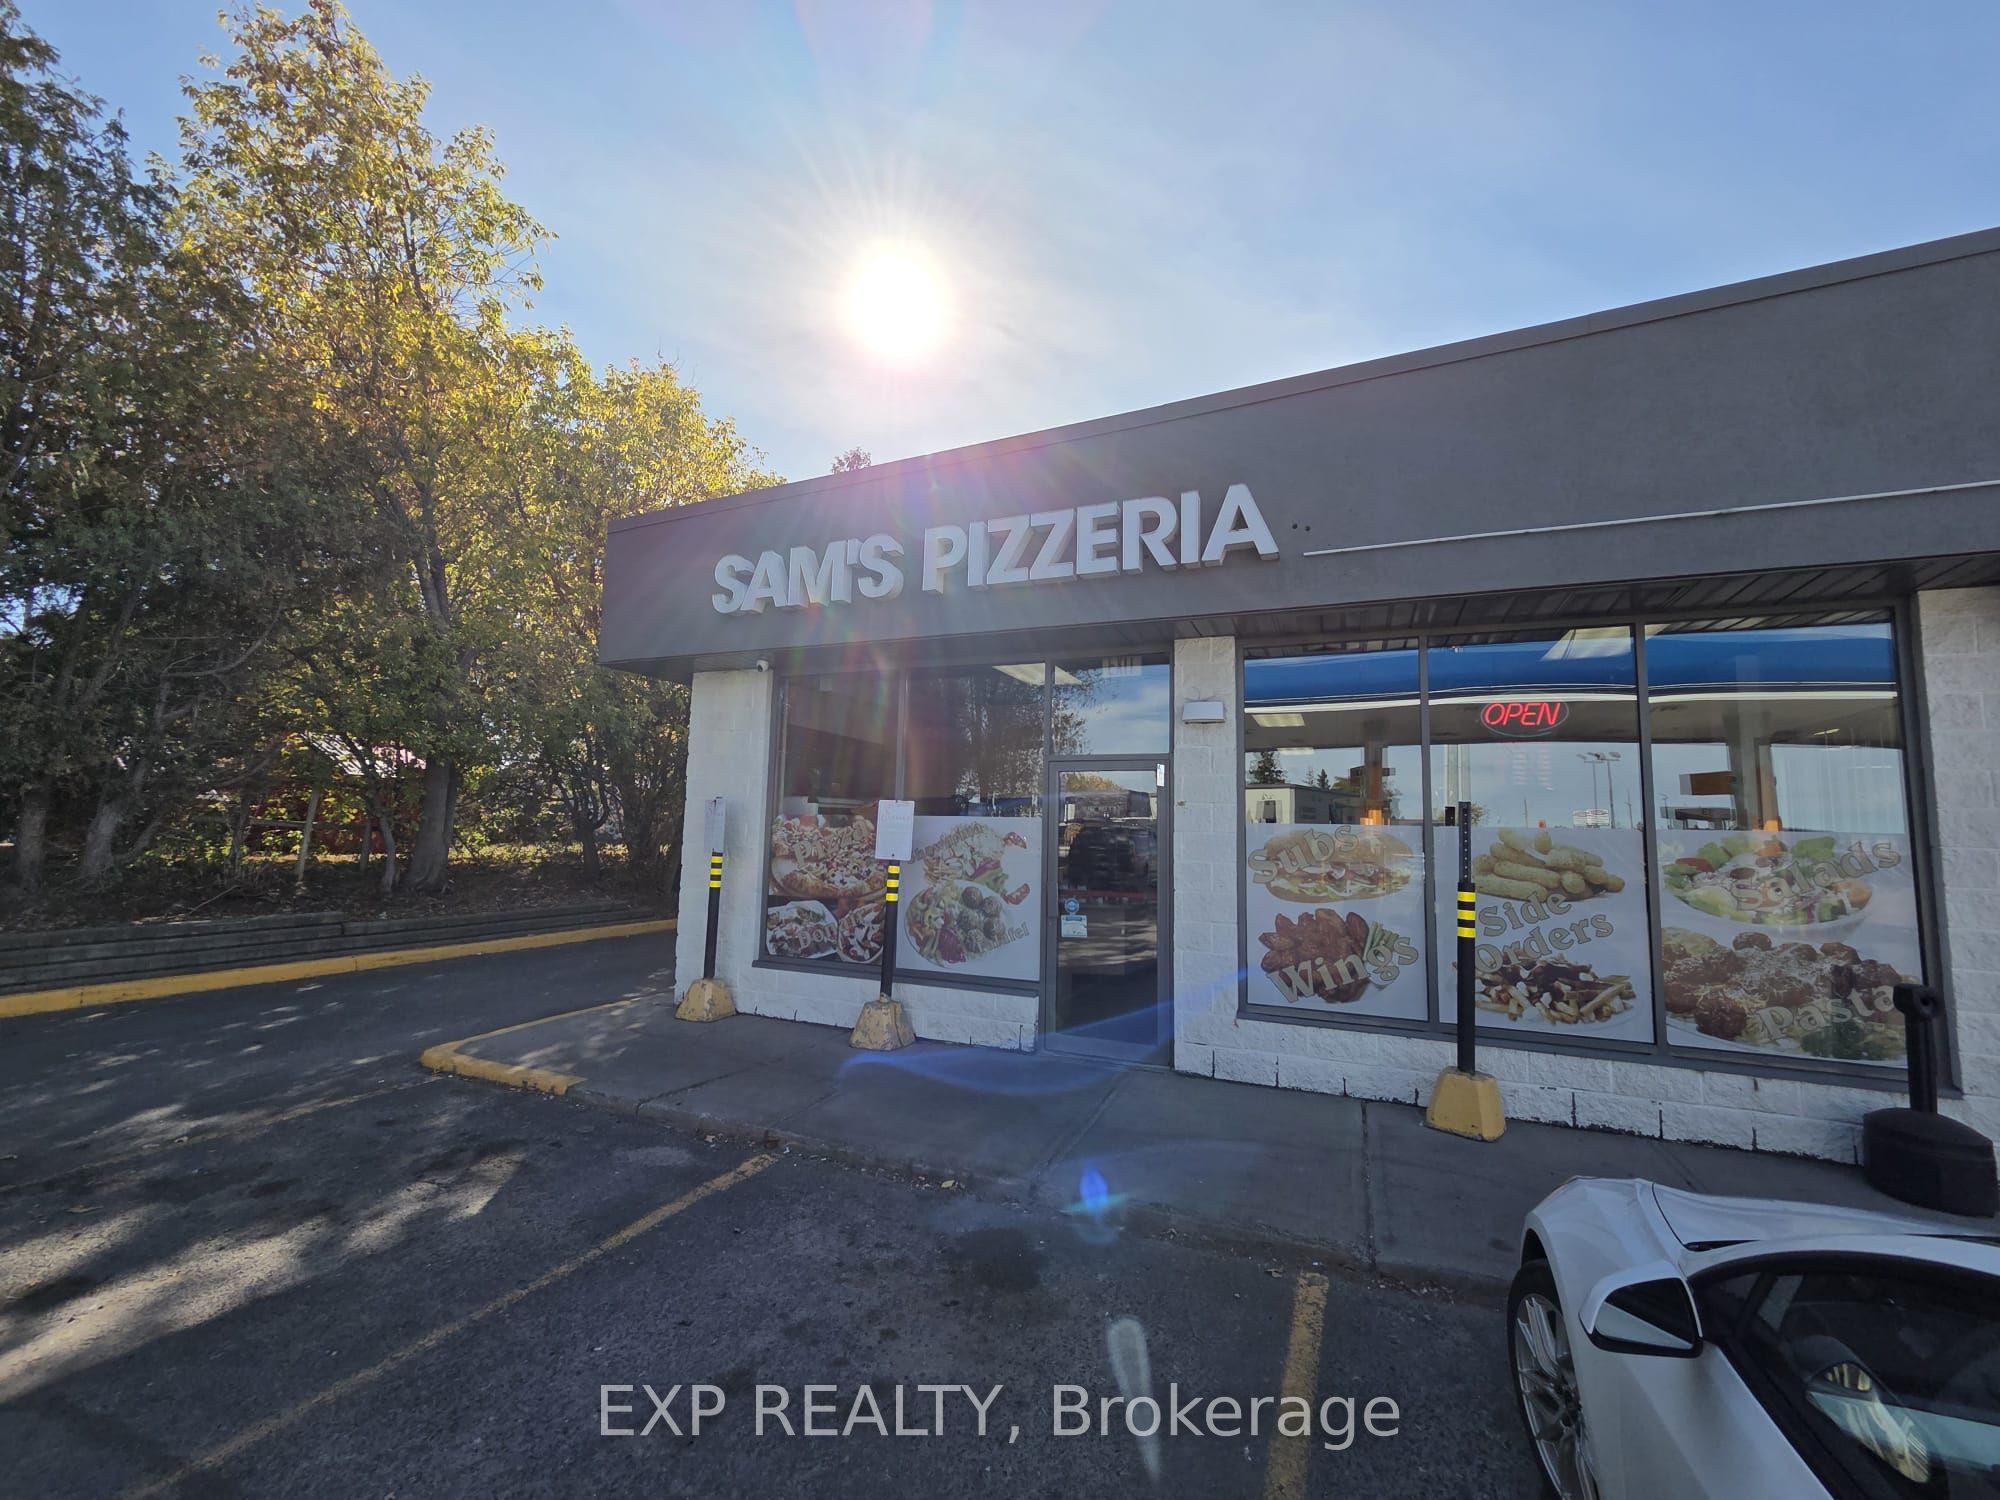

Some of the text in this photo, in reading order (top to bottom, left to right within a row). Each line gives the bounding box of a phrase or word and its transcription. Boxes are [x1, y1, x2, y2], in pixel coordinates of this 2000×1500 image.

[711, 483, 1279, 615] SAM'S PIZZERIA
[1484, 702, 1561, 727] OPEN
[1248, 825, 1360, 885] Subs
[1730, 840, 1902, 912] Salads
[1475, 914, 1615, 974] Orders
[1478, 891, 1573, 937] Side
[1267, 936, 1420, 1003] Wings
[1758, 985, 1895, 1041] Pasta
